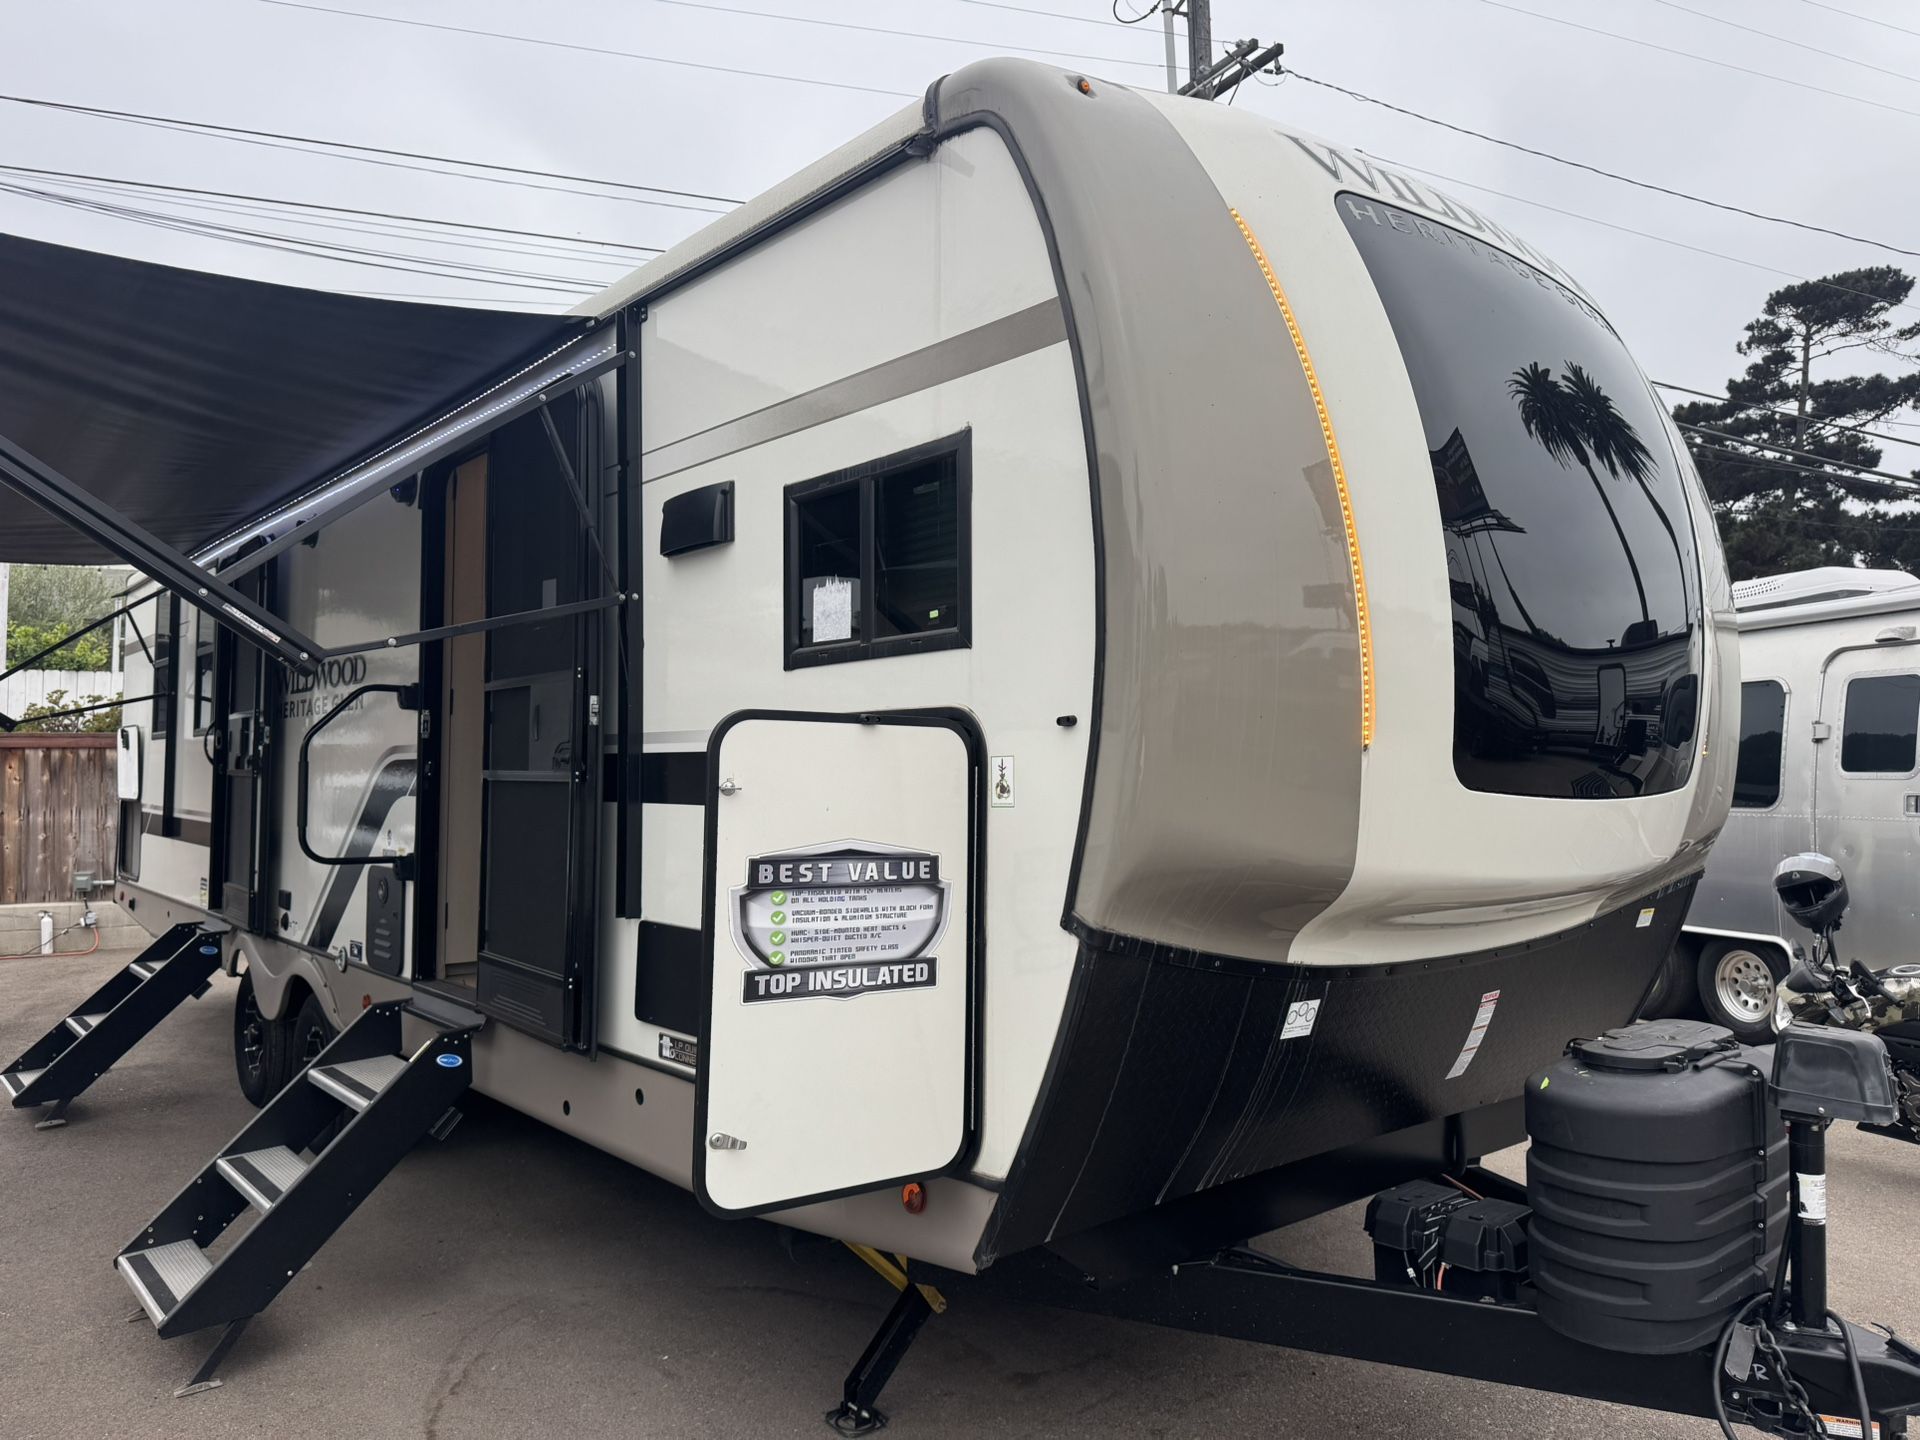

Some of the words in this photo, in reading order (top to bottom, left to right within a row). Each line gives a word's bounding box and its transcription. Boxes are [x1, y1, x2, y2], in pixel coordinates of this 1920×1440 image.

[1345, 198, 1550, 291] HERITAGE
[758, 863, 832, 884] BEST
[848, 861, 931, 881] VALUE
[792, 908, 842, 916] VACUUM-BONDED
[845, 906, 879, 914] SIDEWALLS
[792, 915, 831, 924] INSULATION
[841, 913, 872, 921] ALUMINUM
[875, 911, 907, 919] STRUCTURE
[815, 926, 860, 935] SIDE-MOUNTED
[790, 935, 841, 943] WHISPER-QUIET
[830, 946, 852, 954] TINTED
[790, 956, 818, 964] WINDOWS
[755, 974, 801, 996] TOP
[808, 962, 929, 991] INSULATED
